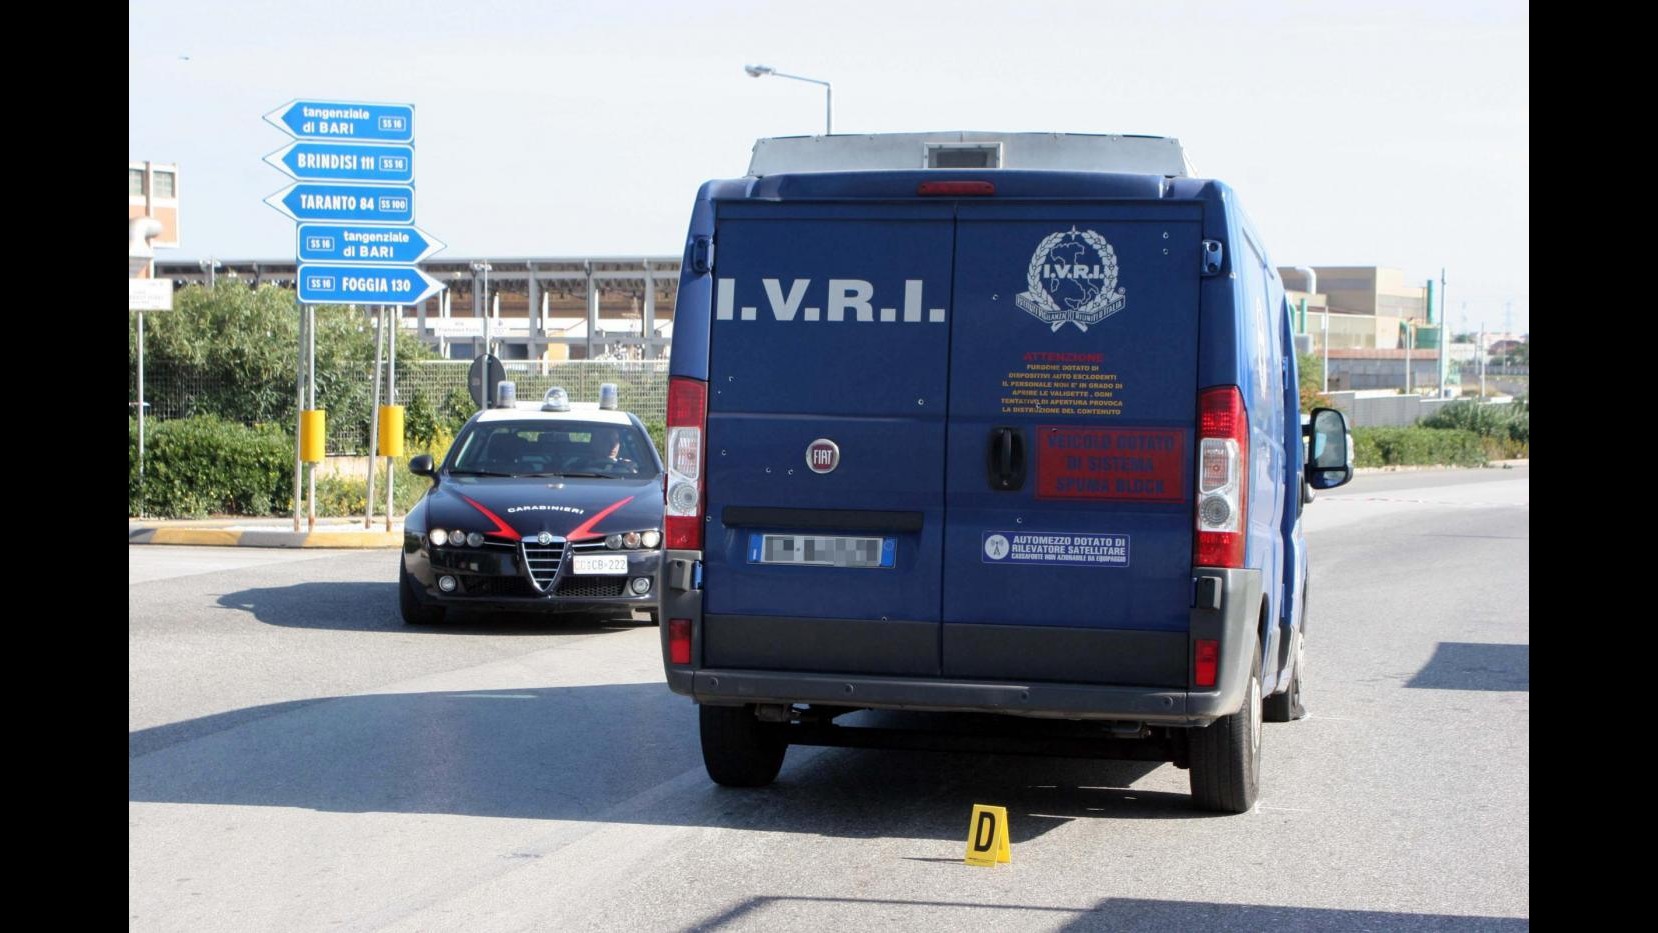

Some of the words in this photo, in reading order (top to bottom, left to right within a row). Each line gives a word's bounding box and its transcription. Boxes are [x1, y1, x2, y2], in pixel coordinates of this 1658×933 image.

[303, 106, 369, 120] tangenziale
[303, 122, 315, 133] di
[319, 122, 354, 135] BARI
[382, 119, 392, 129] SS
[393, 119, 402, 129] 16
[297, 153, 357, 170] BRINDISI
[361, 156, 375, 170] 111
[383, 159, 393, 169] SS
[394, 160, 403, 169] 16
[301, 194, 356, 211] TARANTO
[360, 197, 375, 211] 84
[380, 200, 390, 209] SS
[391, 200, 406, 210] 100
[311, 239, 320, 249] SS
[321, 239, 331, 249] 16
[343, 231, 409, 244] tangenziale
[343, 246, 355, 257] di
[359, 246, 394, 258] BARI
[1043, 264, 1104, 279] I.V.R.I.
[311, 279, 321, 288] SS
[322, 279, 331, 288] 16
[342, 277, 388, 292] FOGGIA
[391, 279, 411, 292] 130
[716, 277, 946, 323] I.V.R.I.
[1047, 433, 1112, 450] VEICOLO
[1116, 434, 1174, 451] DOTATO
[813, 449, 832, 465] FIAT
[1066, 456, 1083, 471] DI
[1088, 456, 1154, 472] SISTEMA
[1056, 477, 1110, 493] SPUMA
[1115, 479, 1165, 494] BLOCK
[507, 505, 585, 515] CARABINIERI
[1013, 535, 1071, 545] AUTOMEZZO
[1073, 536, 1113, 546] DOTATO
[1115, 538, 1125, 547] DI
[1011, 544, 1066, 554] RILEVATORE
[1068, 545, 1126, 556] SATELLITARE
[974, 811, 996, 852] D
